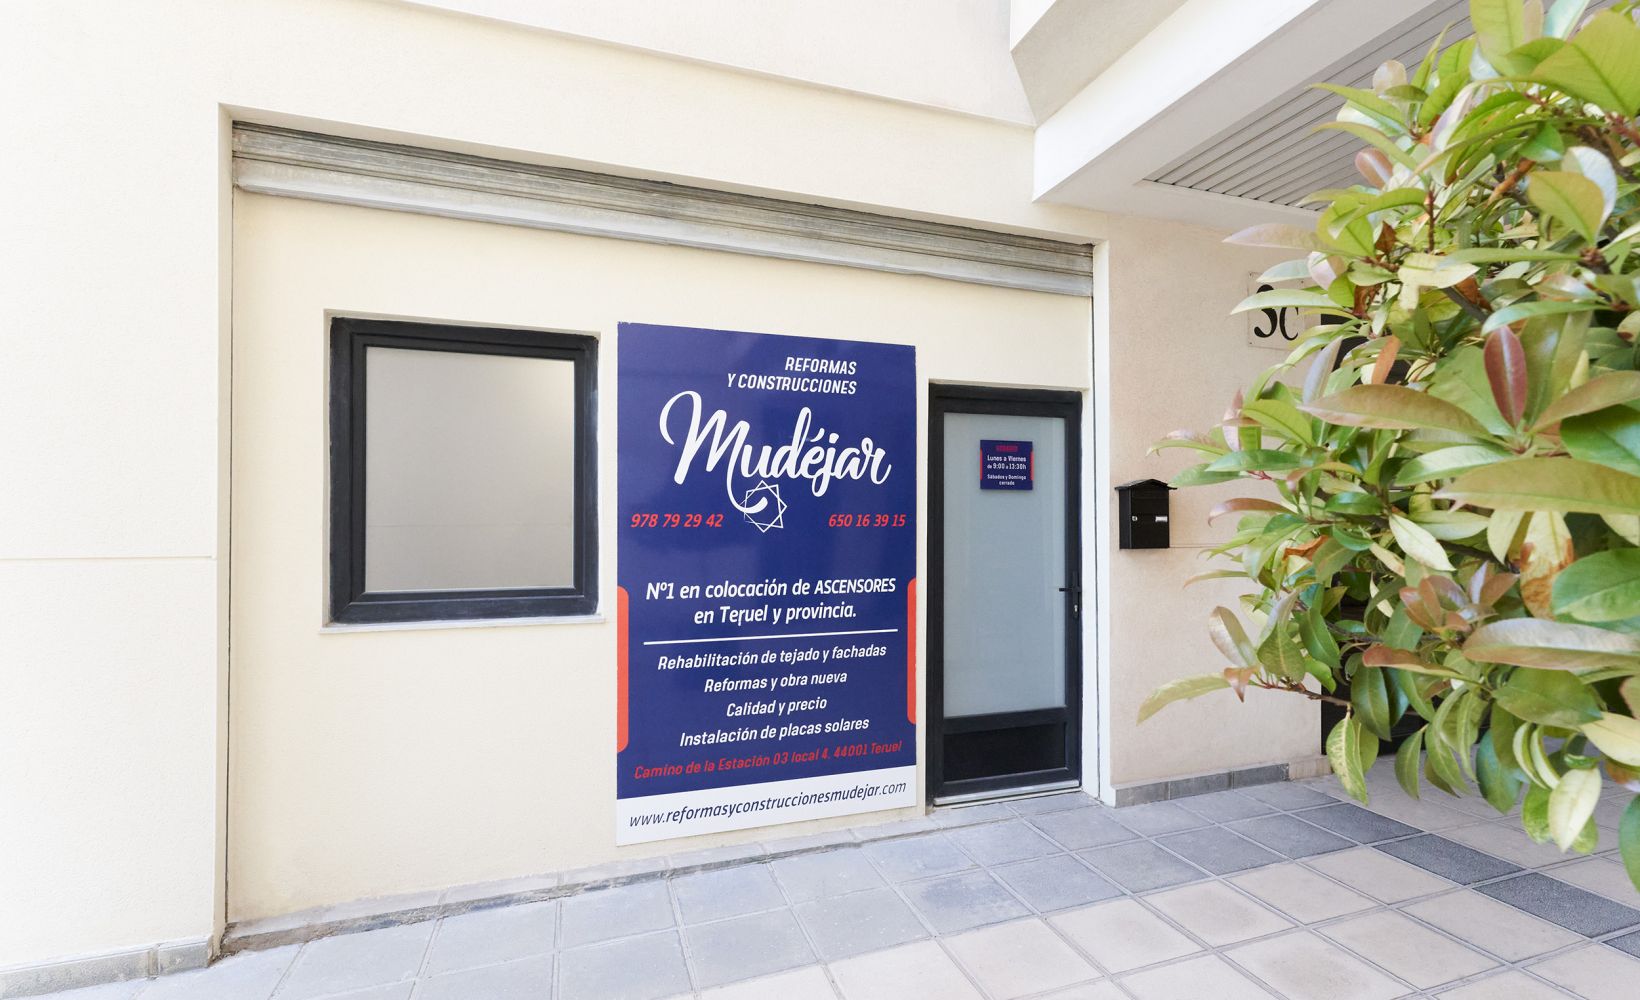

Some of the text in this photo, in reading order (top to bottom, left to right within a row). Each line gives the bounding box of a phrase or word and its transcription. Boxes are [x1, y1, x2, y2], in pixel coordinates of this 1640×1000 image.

[785, 357, 857, 375] REFORMAS
[727, 373, 857, 395] Y CONSTRUCCIONES
[659, 390, 892, 514] Mudéjar
[630, 513, 724, 528] 978 79 29 42
[828, 514, 906, 527] 650 16 39 15
[679, 584, 701, 599] en
[705, 579, 787, 599] colocación
[791, 578, 810, 596] de
[814, 577, 896, 595] ASCENSORES
[694, 601, 857, 626] en Teruel y provincia.
[657, 644, 887, 670] Rehabilitación de tejado y fachadas
[704, 671, 847, 693] Reformas y obra nueva
[726, 697, 827, 717] Calidad y precio
[680, 717, 870, 747] Instalación de placas solares
[634, 764, 682, 779] Camino
[685, 760, 701, 775] de
[703, 759, 715, 773] la
[717, 754, 770, 771] Estación
[773, 752, 789, 765] 03
[791, 748, 819, 762] local
[833, 744, 868, 759] 44001
[871, 740, 902, 755] Teruel
[629, 780, 907, 828] www.reformasyconstruccionesmudejar.com
